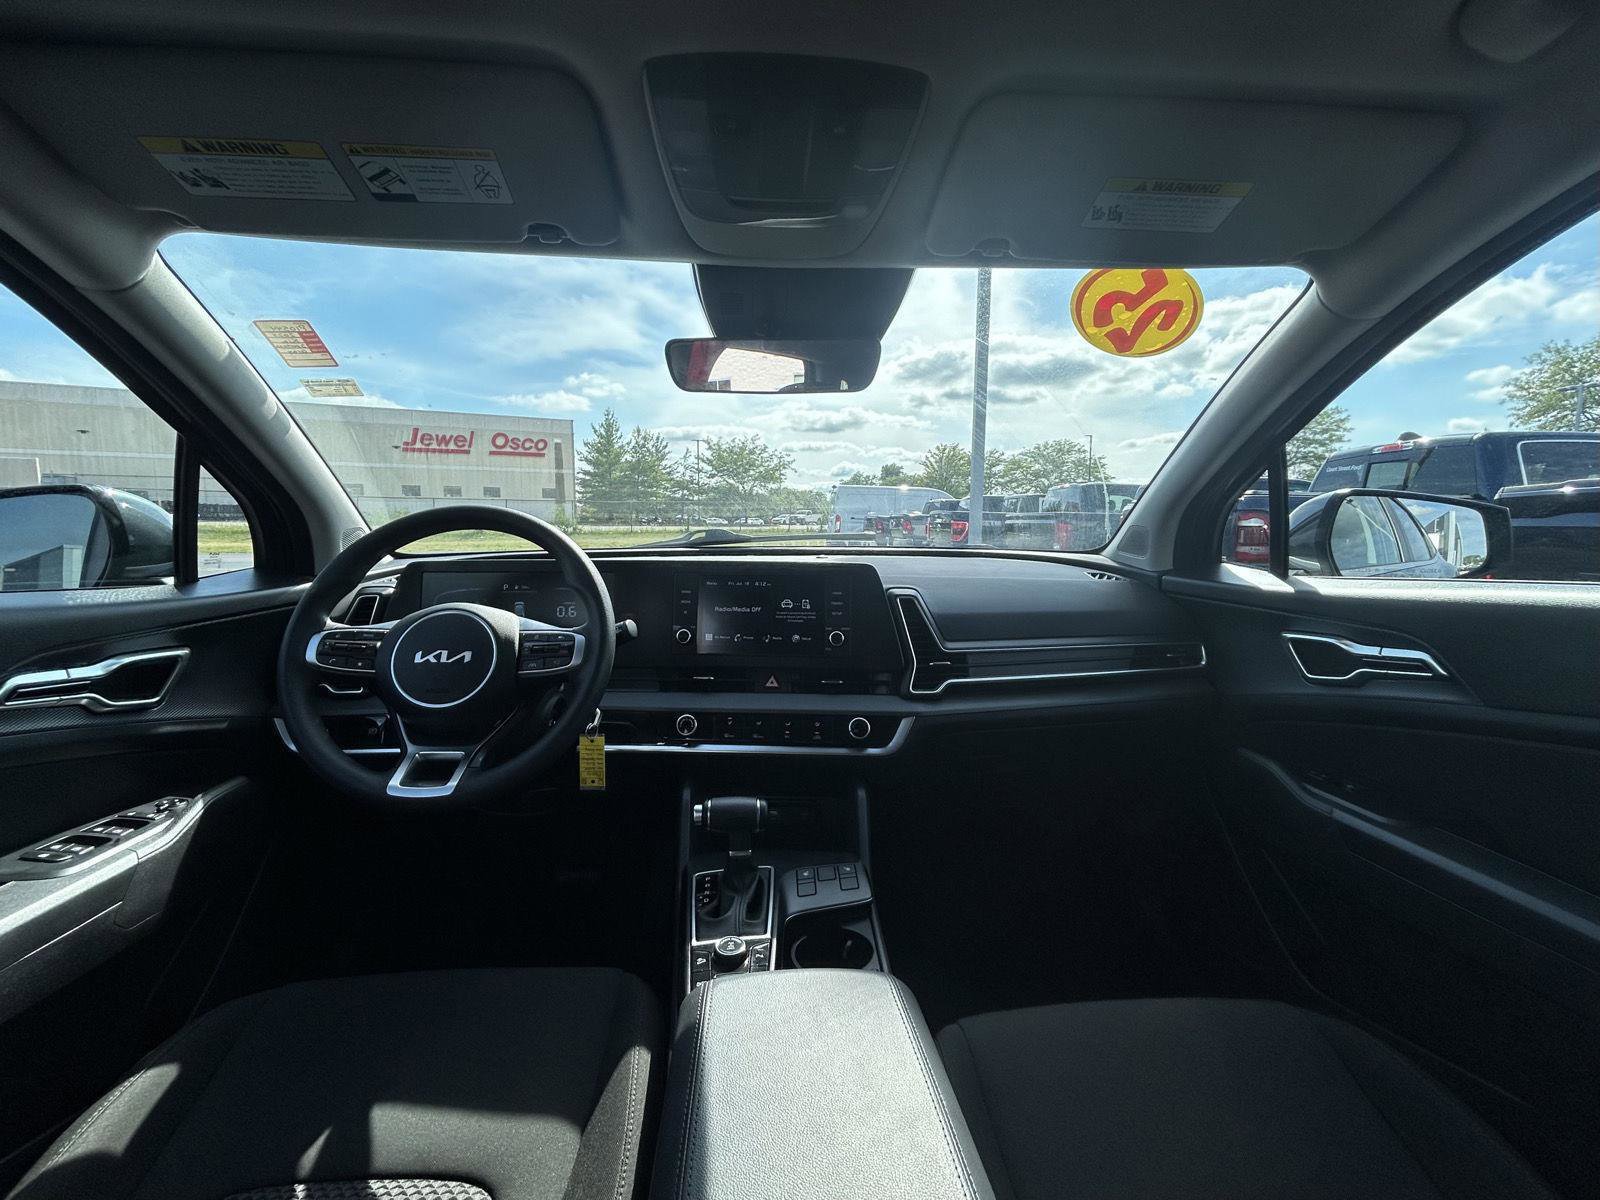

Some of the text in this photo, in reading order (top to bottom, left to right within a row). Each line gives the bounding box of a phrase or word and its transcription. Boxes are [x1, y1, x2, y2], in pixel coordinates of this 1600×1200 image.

[198, 140, 288, 156] WARNING
[1152, 181, 1223, 194] WARNING
[402, 427, 548, 451] Jewel Osco
[414, 649, 473, 663] KIA
